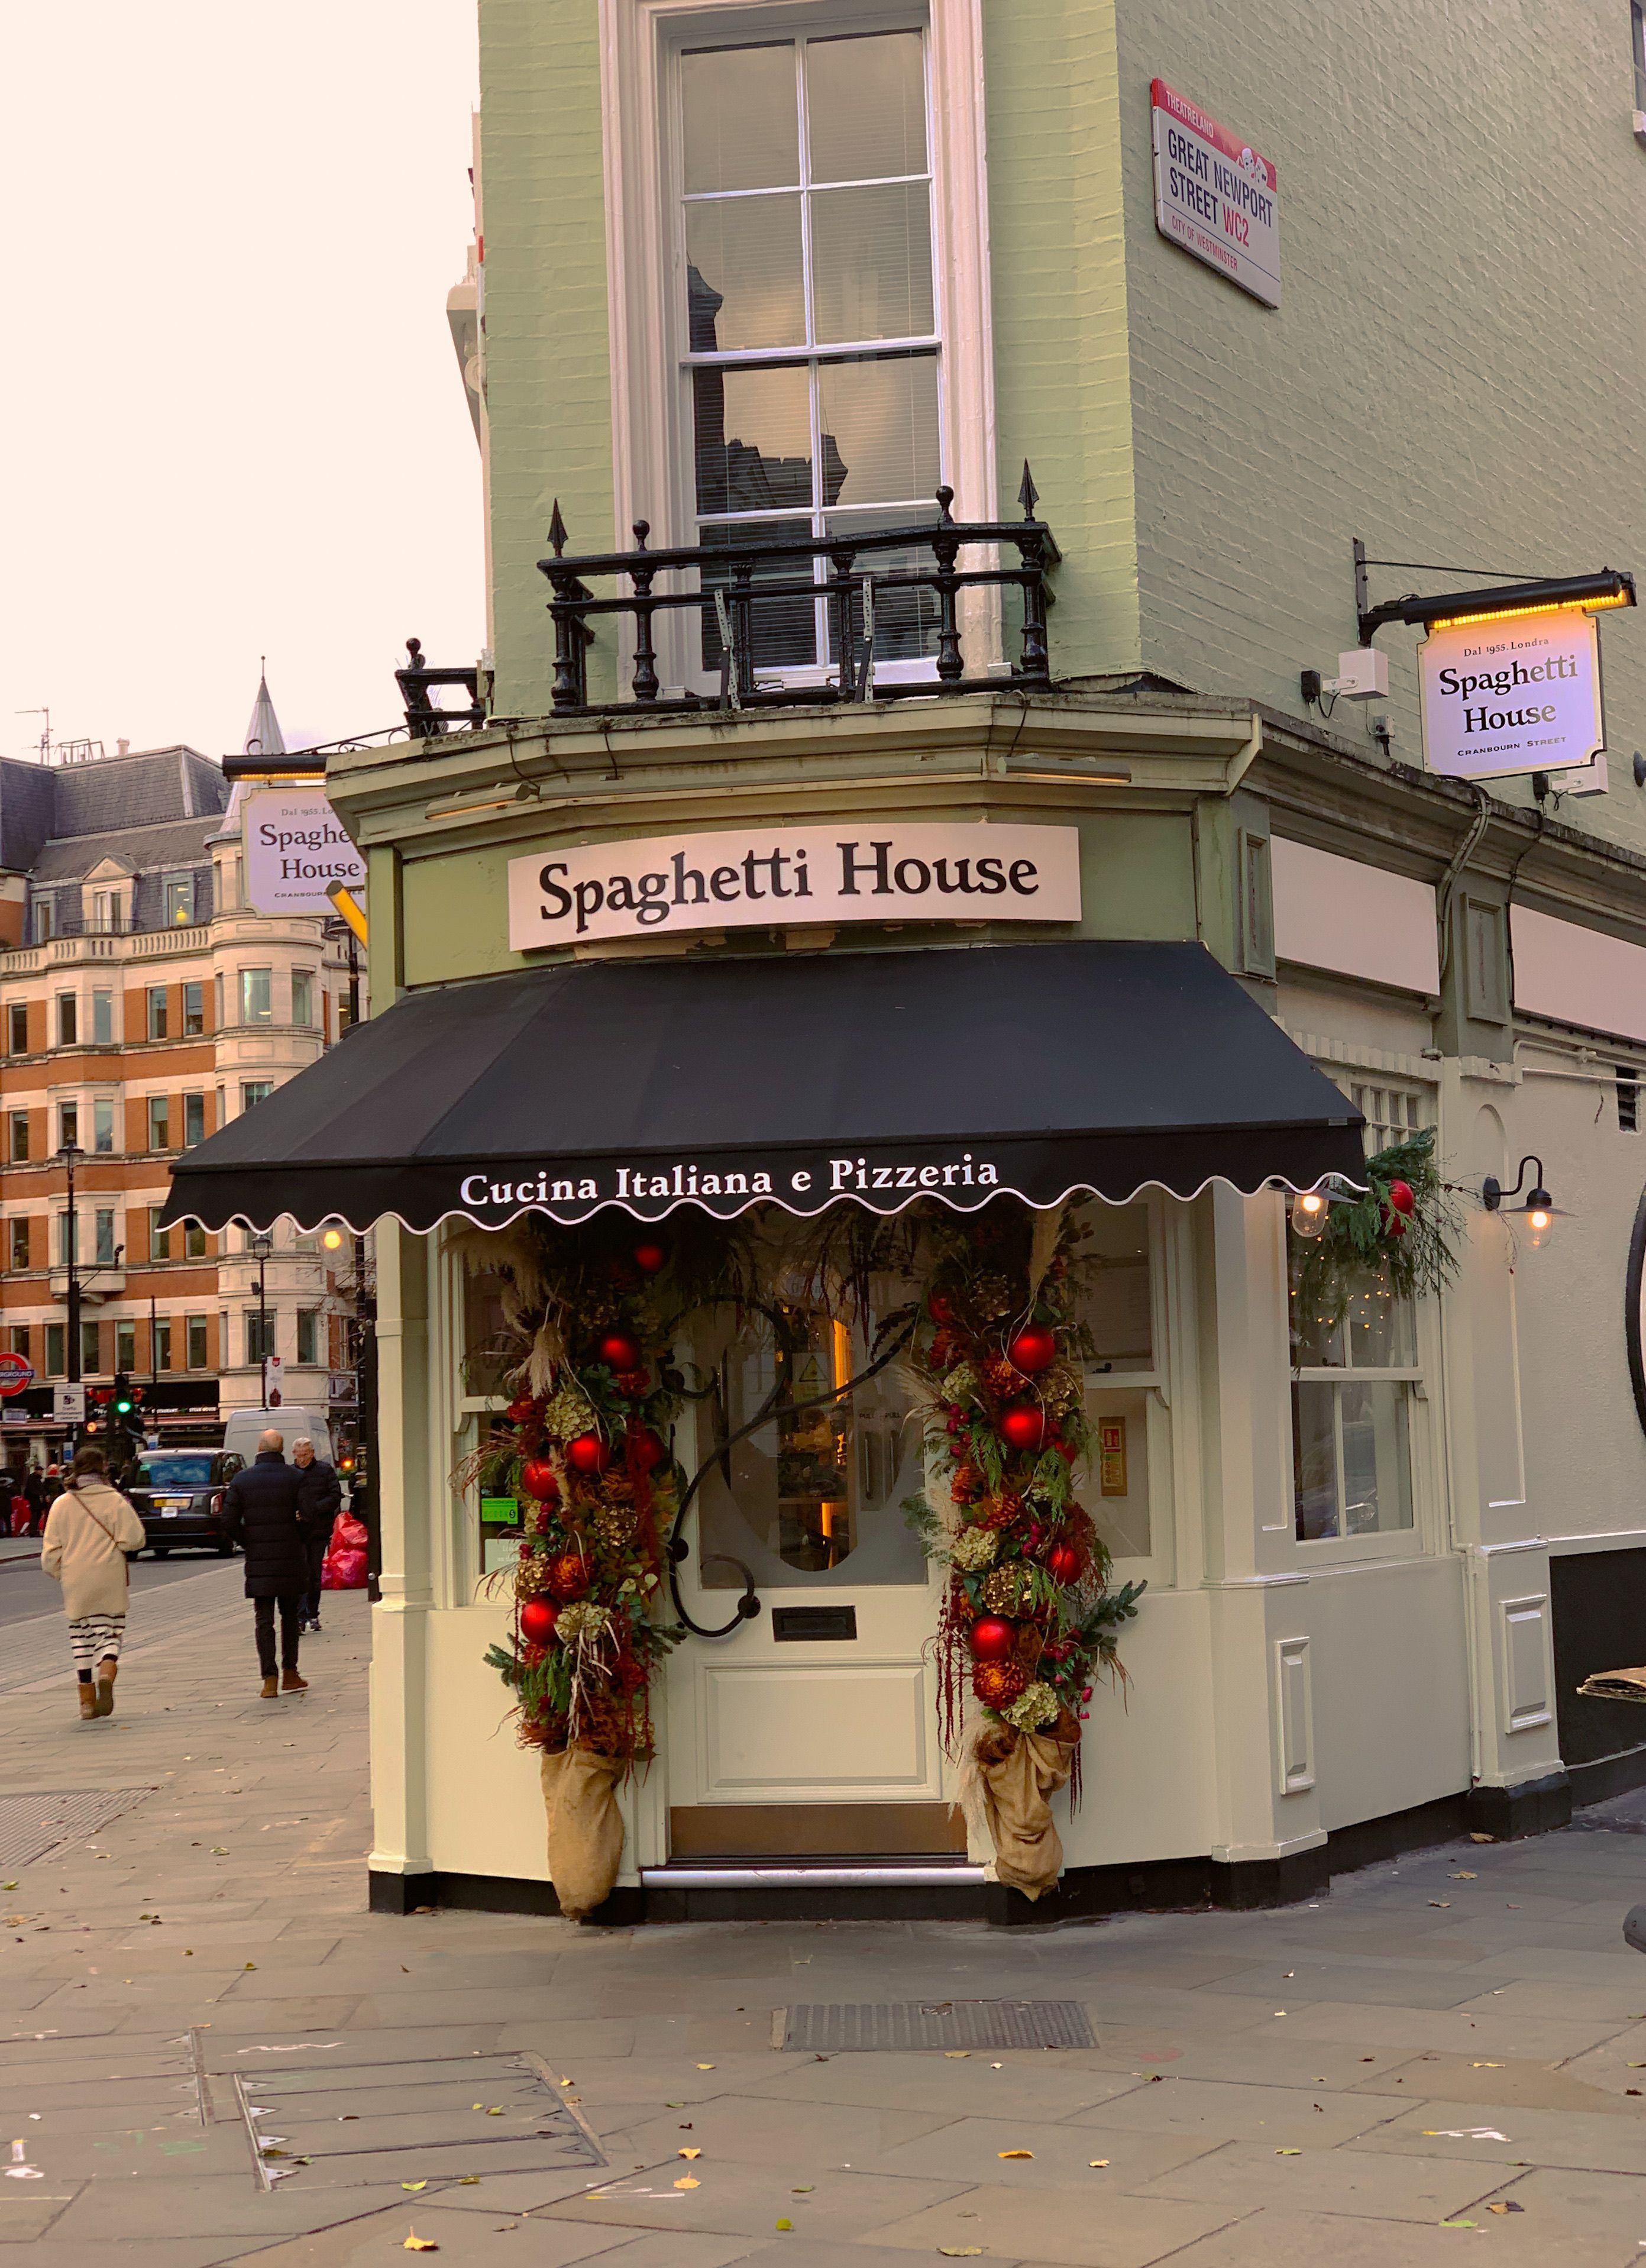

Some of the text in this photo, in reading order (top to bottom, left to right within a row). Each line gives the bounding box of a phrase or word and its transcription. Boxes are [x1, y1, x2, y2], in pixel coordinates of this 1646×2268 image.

[1166, 90, 1214, 139] THEATRELAND
[1168, 128, 1272, 228] GREAT NEWPORT
[1170, 166, 1249, 248] STREET WC2
[1171, 215, 1238, 272] CITY OF WESTMINSTER
[1463, 646, 1482, 657] Dal
[1438, 654, 1578, 702] Spaghetti
[1463, 704, 1557, 734] House
[1457, 736, 1567, 757] CRANBOURN STREET
[281, 808, 297, 816] Dal
[280, 858, 360, 880] House
[539, 840, 1040, 934] Spaghetti House
[461, 1154, 1000, 1206] Cucina Italiana e Pizzeria
